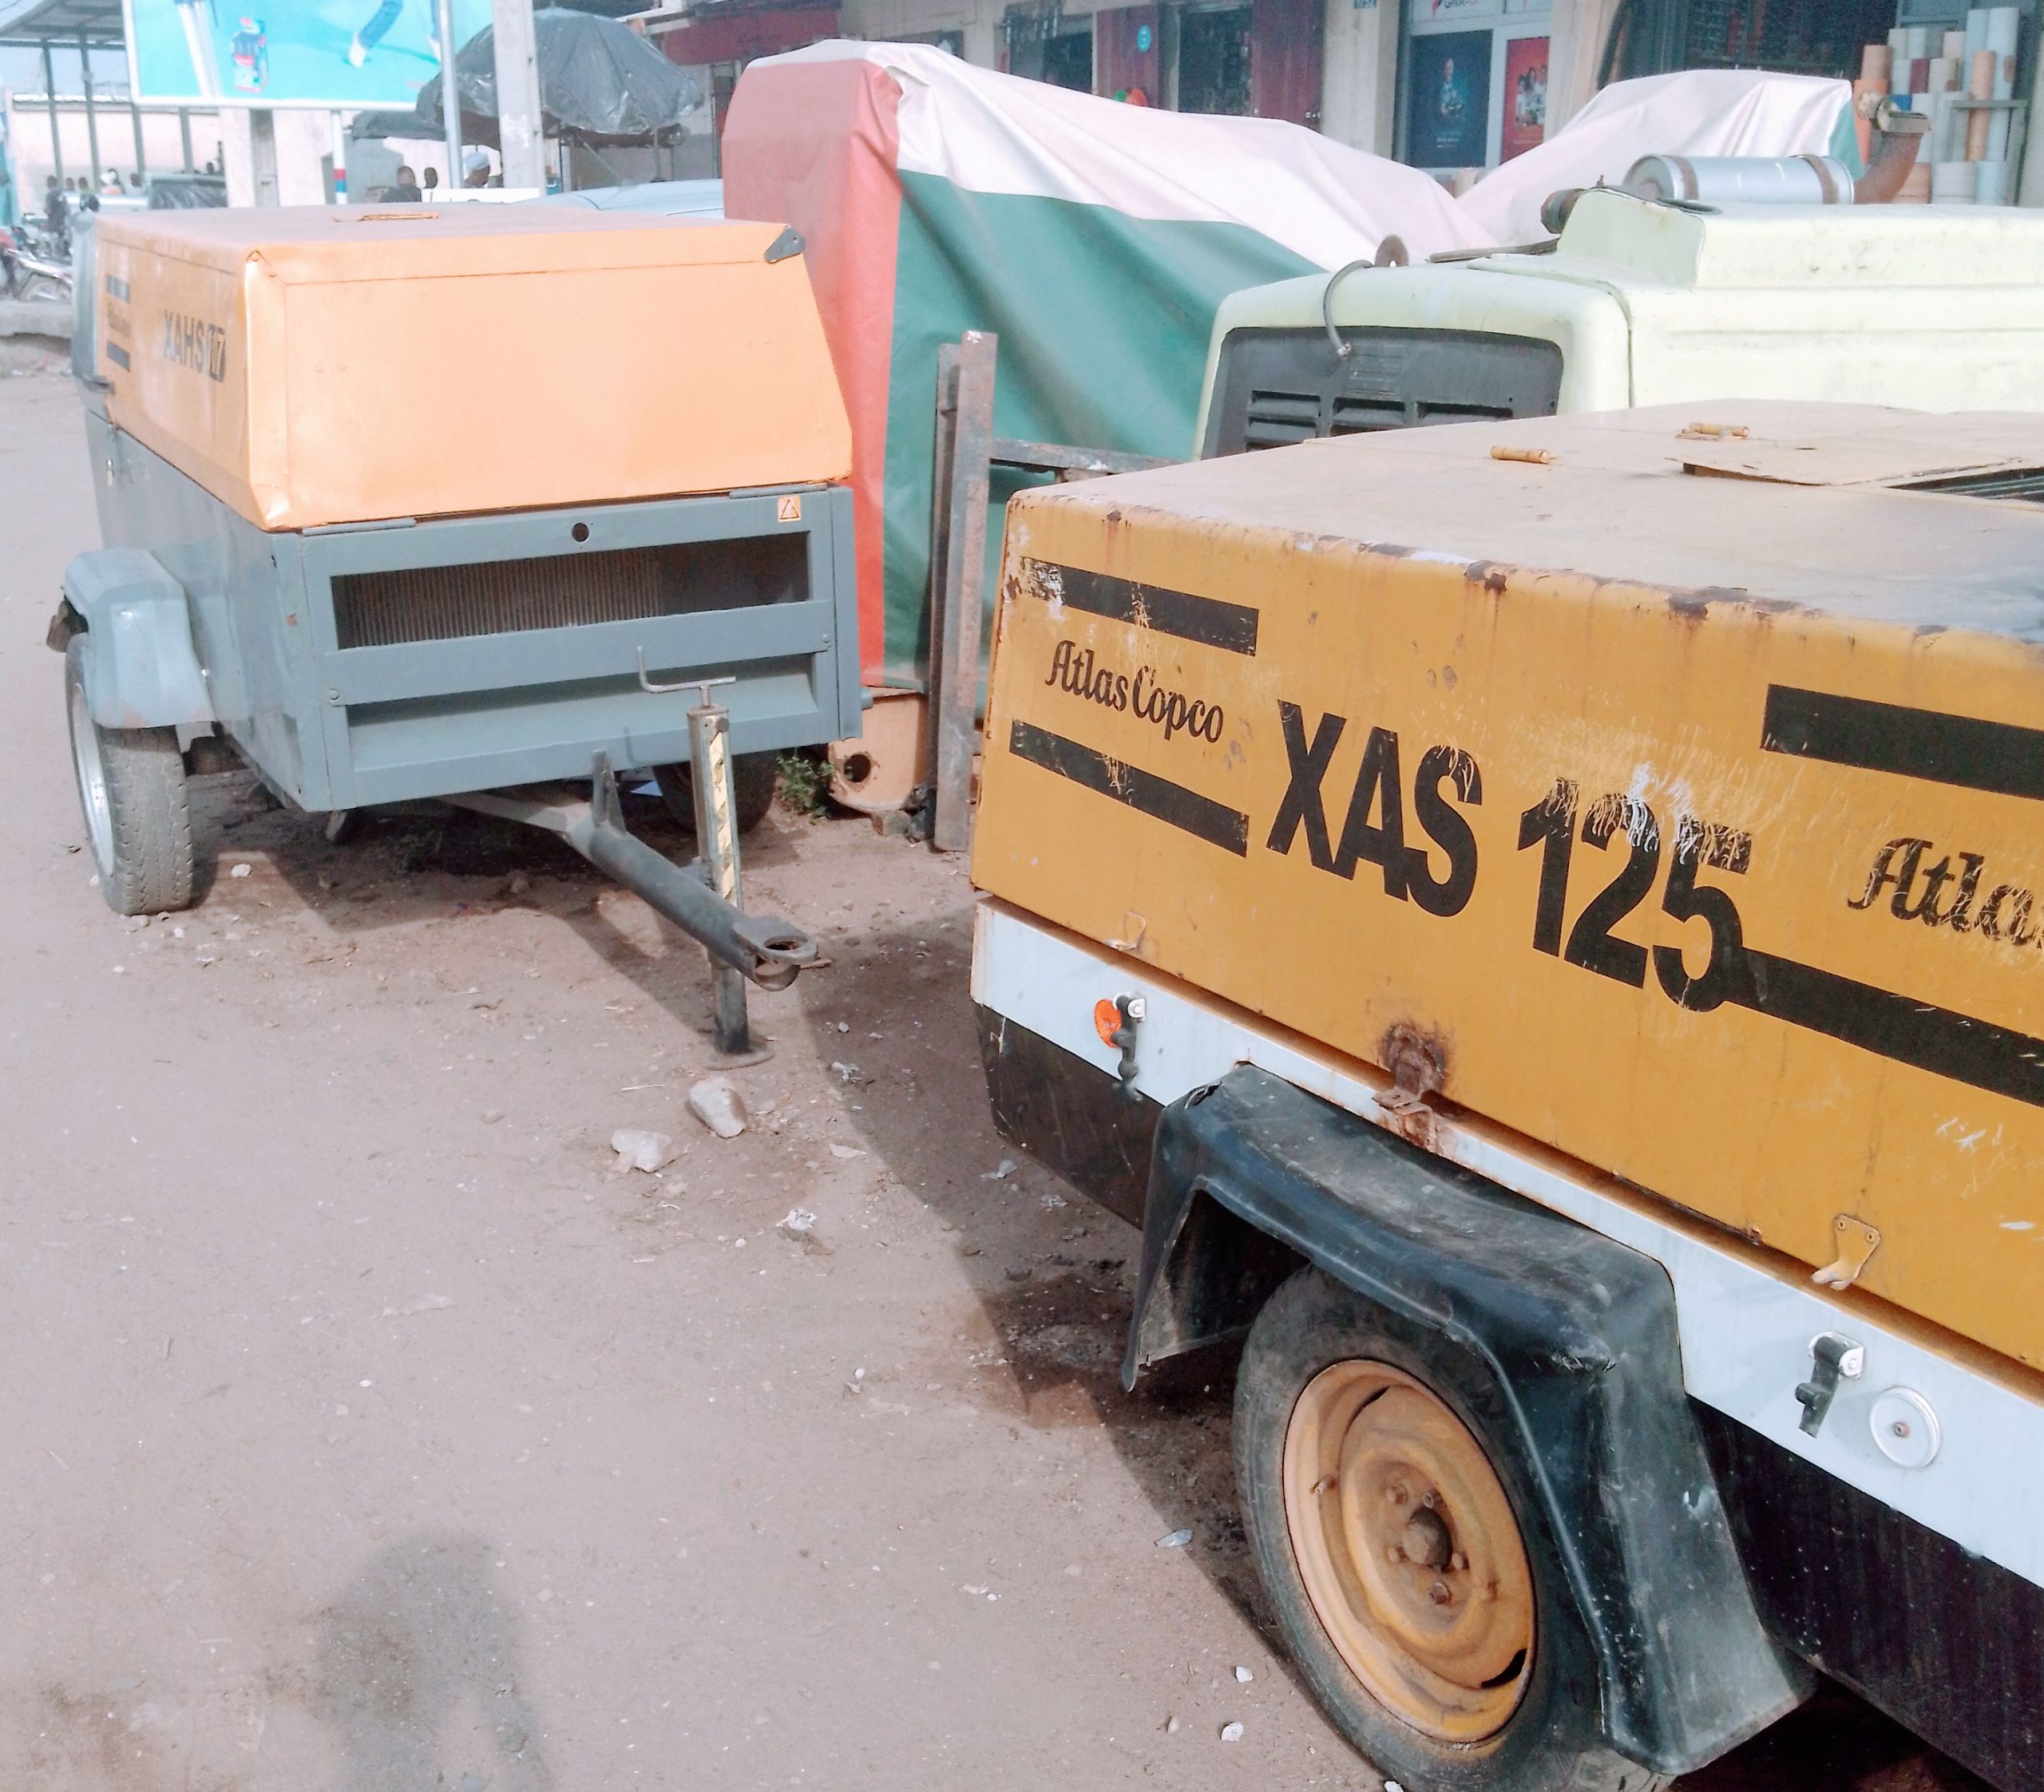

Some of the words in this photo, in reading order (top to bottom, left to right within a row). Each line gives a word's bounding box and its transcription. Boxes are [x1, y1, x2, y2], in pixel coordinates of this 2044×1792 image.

[1266, 699, 1483, 917] XAS
[1518, 777, 1752, 1012] 125
[1848, 837, 2044, 949] Atla
